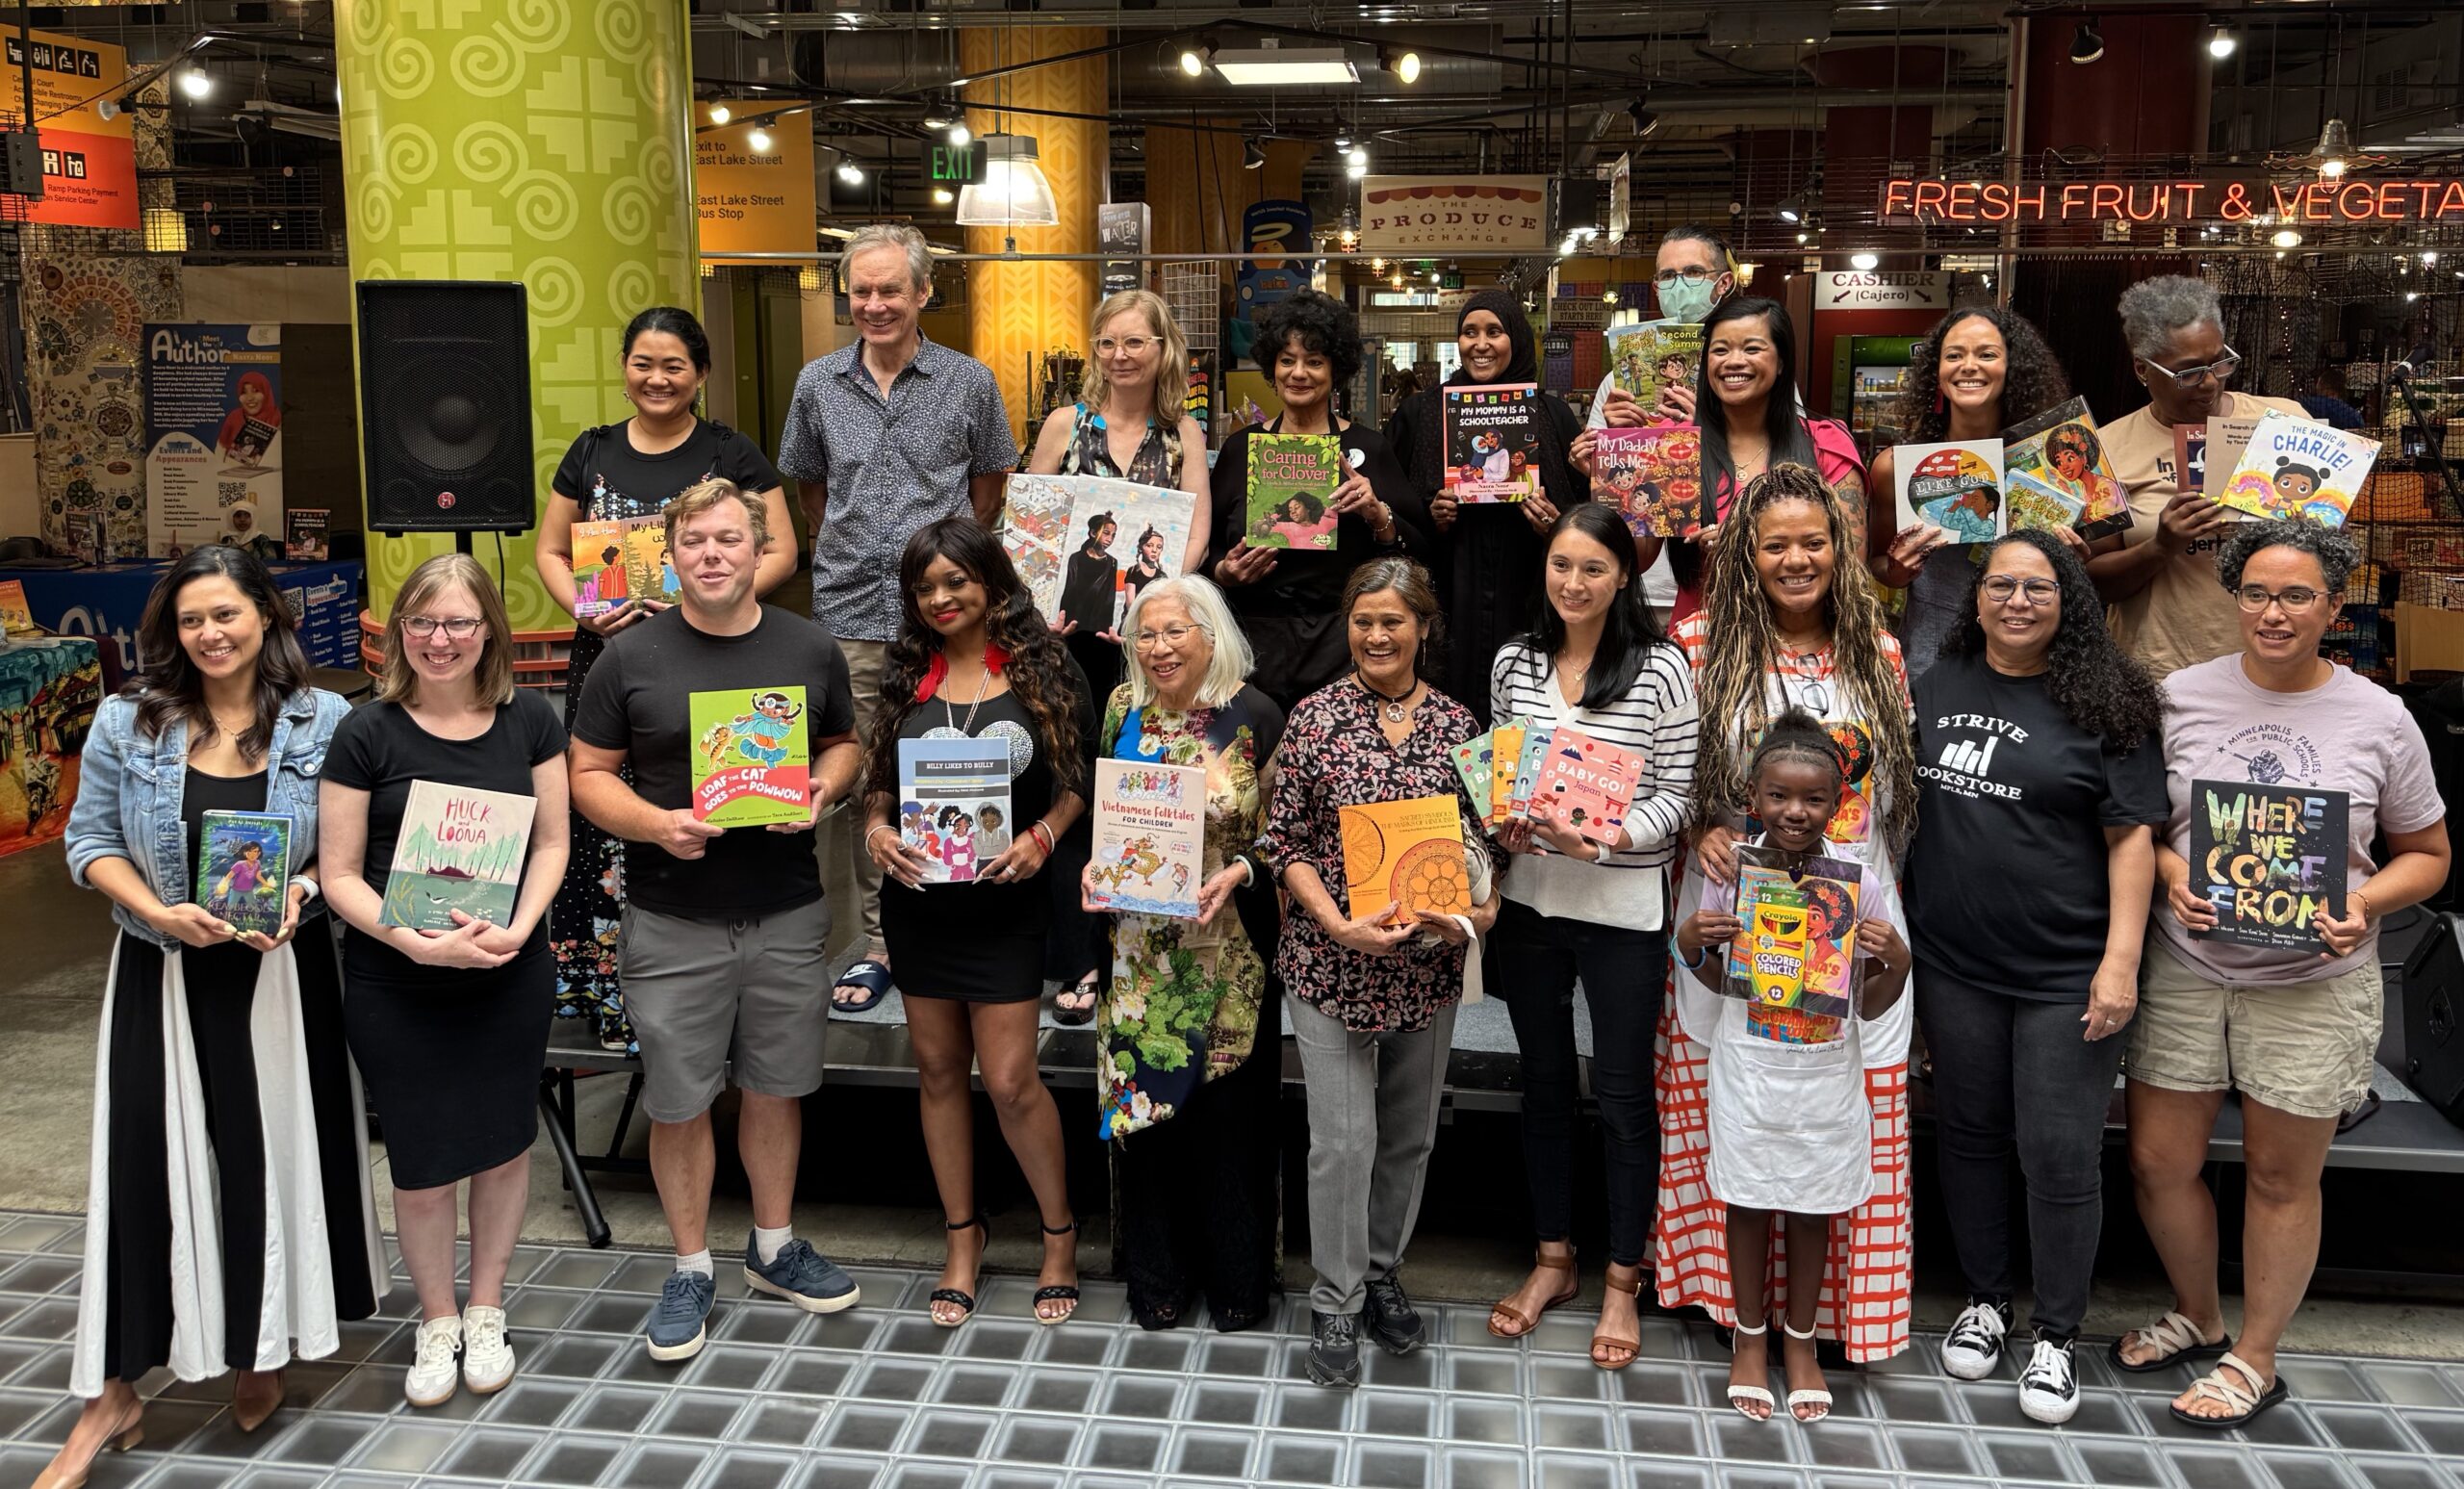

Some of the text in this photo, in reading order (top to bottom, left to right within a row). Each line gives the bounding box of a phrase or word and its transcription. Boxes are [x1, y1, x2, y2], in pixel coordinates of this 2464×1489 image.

[37, 78, 55, 88] Court
[49, 90, 83, 102] Restrooms
[715, 141, 726, 151] to
[719, 154, 746, 165] Lake
[749, 154, 783, 166] Street
[932, 146, 973, 181] EXIT
[47, 184, 118, 198] Ramp Parking Payment
[54, 194, 99, 205] Service Center
[721, 194, 748, 206] Lake
[751, 194, 784, 206] Street
[1886, 181, 2464, 220] FRESH FRUIT & VEGETA
[718, 208, 744, 220] Stop
[1370, 213, 1537, 230] PRODUCE
[1399, 234, 1509, 244] EXCHANGE
[1445, 275, 1461, 288] EXIT
[1832, 272, 1936, 287] CASHIER
[1856, 290, 1910, 302] (Cajero)
[1553, 302, 1611, 311] CHECK OUT LINE
[1559, 312, 1603, 321] STARTS HERE
[1661, 330, 1698, 341] Second
[152, 329, 231, 364] Author
[1461, 407, 1474, 416] MY
[1476, 406, 1507, 416] MOMMY
[1519, 405, 1526, 414] A
[1459, 416, 1528, 426] SCHOOLTEACHER
[2187, 431, 2194, 440] In
[2292, 425, 2348, 449] THE MAGIC IN
[1598, 438, 1656, 453] My Daddy
[2273, 434, 2353, 472] CHARLIE!
[155, 455, 207, 464] Appearances
[1263, 449, 1317, 468] Caring
[1598, 453, 1626, 470] Tells
[2156, 458, 2174, 473] In
[1262, 465, 1330, 480] for Clover
[1915, 472, 1989, 496] LIKE GOD
[2013, 482, 2071, 520] Everything
[2015, 494, 2059, 522] Together
[631, 524, 648, 532] My
[1938, 713, 2029, 744] STRIVE
[2228, 724, 2322, 774] MINNEAPOLIS FAMILIES
[2262, 732, 2294, 746] PUBLIC
[2293, 744, 2310, 778] SCHOOLS
[701, 775, 728, 799] LOAF
[741, 768, 768, 781] CAT
[1556, 760, 1626, 795] BABY GO!
[1916, 766, 2022, 800] OOKSTORE
[704, 790, 729, 811] GOES
[749, 781, 804, 802] POWWOW
[1574, 781, 1601, 797] Japan
[1940, 783, 1979, 799] MPLS, MN
[446, 797, 492, 823] HUCK
[1102, 800, 1152, 816] Vietnamese
[1155, 806, 1195, 822] Folktales
[1140, 818, 1173, 828] CHILDREN
[2206, 788, 2327, 845] WHERE
[437, 821, 486, 845] LOONA
[2250, 834, 2296, 860] WE
[2206, 844, 2327, 892] COME
[1760, 893, 1772, 903] 12
[2206, 886, 2329, 929] FROM
[1763, 911, 1798, 921] Crayola
[1755, 953, 1802, 968] COLORED
[1757, 963, 1799, 979] PENCILS
[1771, 988, 1782, 998] 12
